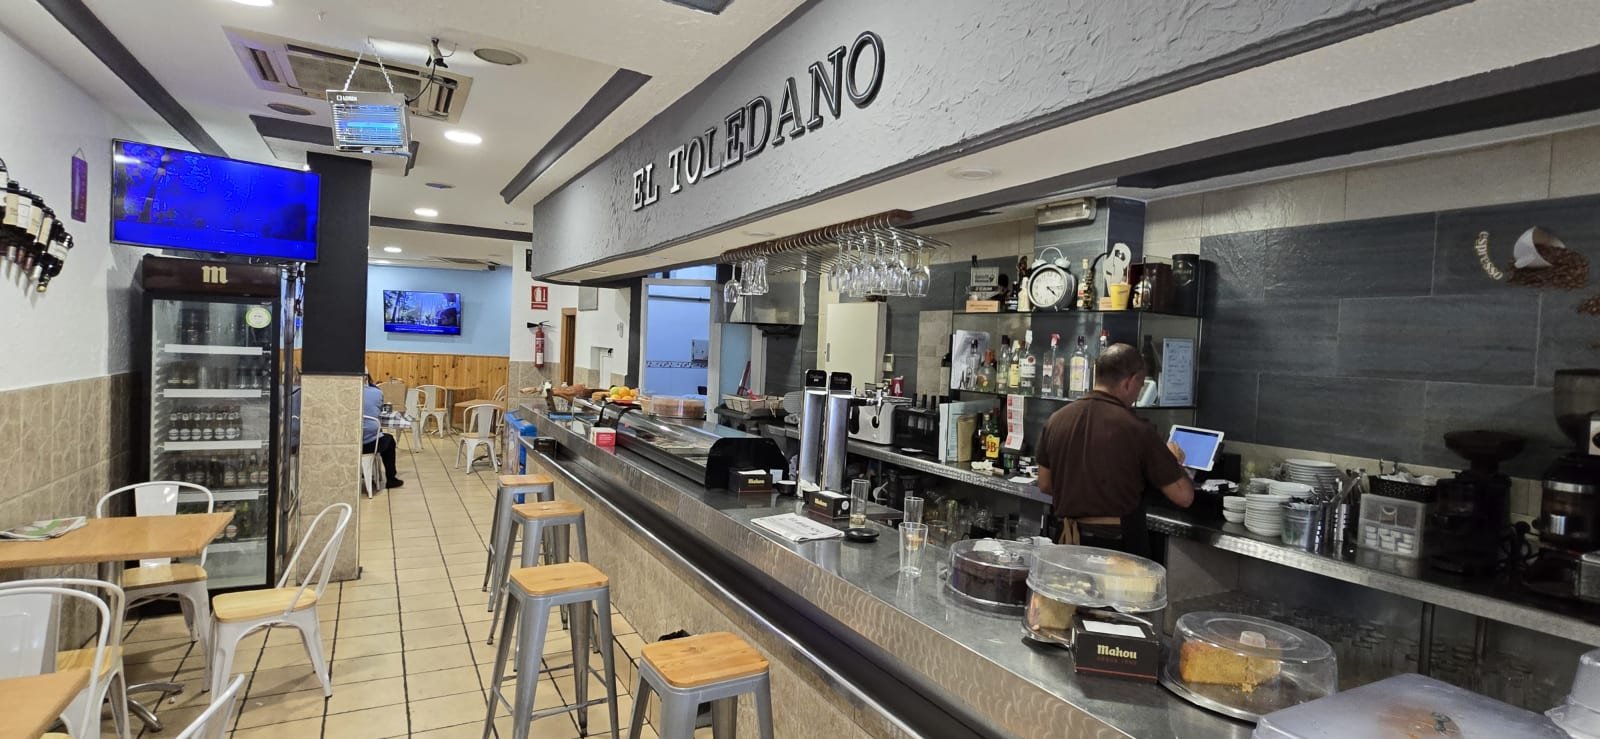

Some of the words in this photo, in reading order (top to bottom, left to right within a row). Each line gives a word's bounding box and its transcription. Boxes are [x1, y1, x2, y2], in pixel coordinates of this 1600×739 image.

[632, 162, 659, 211] EL
[668, 30, 886, 194] TOLEDANO
[1474, 230, 1504, 281] espresso
[1097, 644, 1137, 660] Mahou
